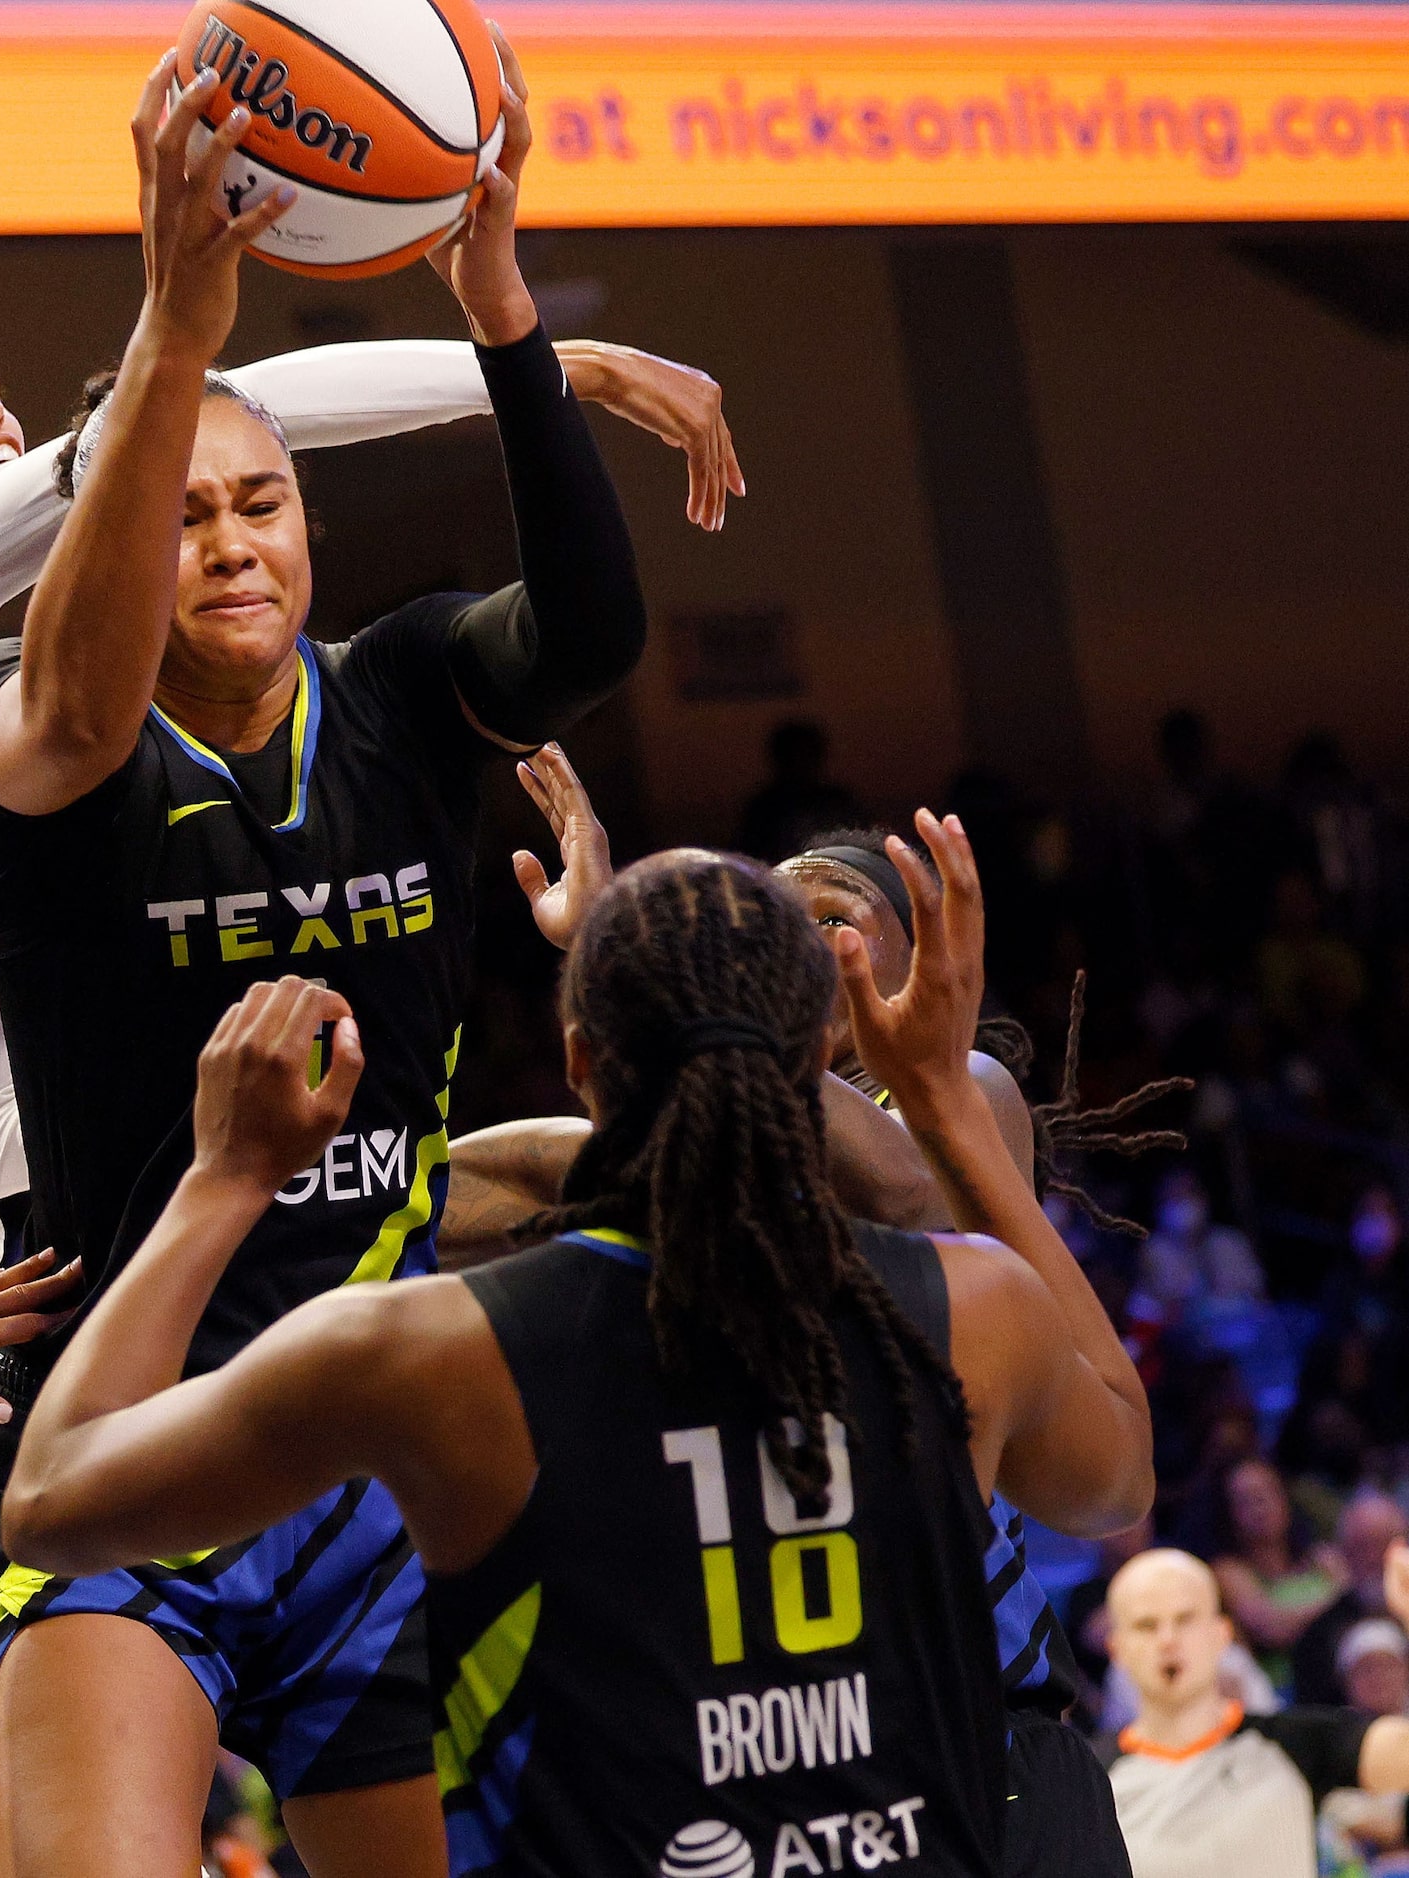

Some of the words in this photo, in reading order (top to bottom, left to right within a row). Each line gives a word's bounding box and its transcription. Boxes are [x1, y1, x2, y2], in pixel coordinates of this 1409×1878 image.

[193, 14, 373, 175] Wilson
[545, 88, 636, 163] at
[147, 861, 434, 967] TEXAS
[697, 1672, 872, 1786] BROWN
[771, 1796, 926, 1878] AT&T
